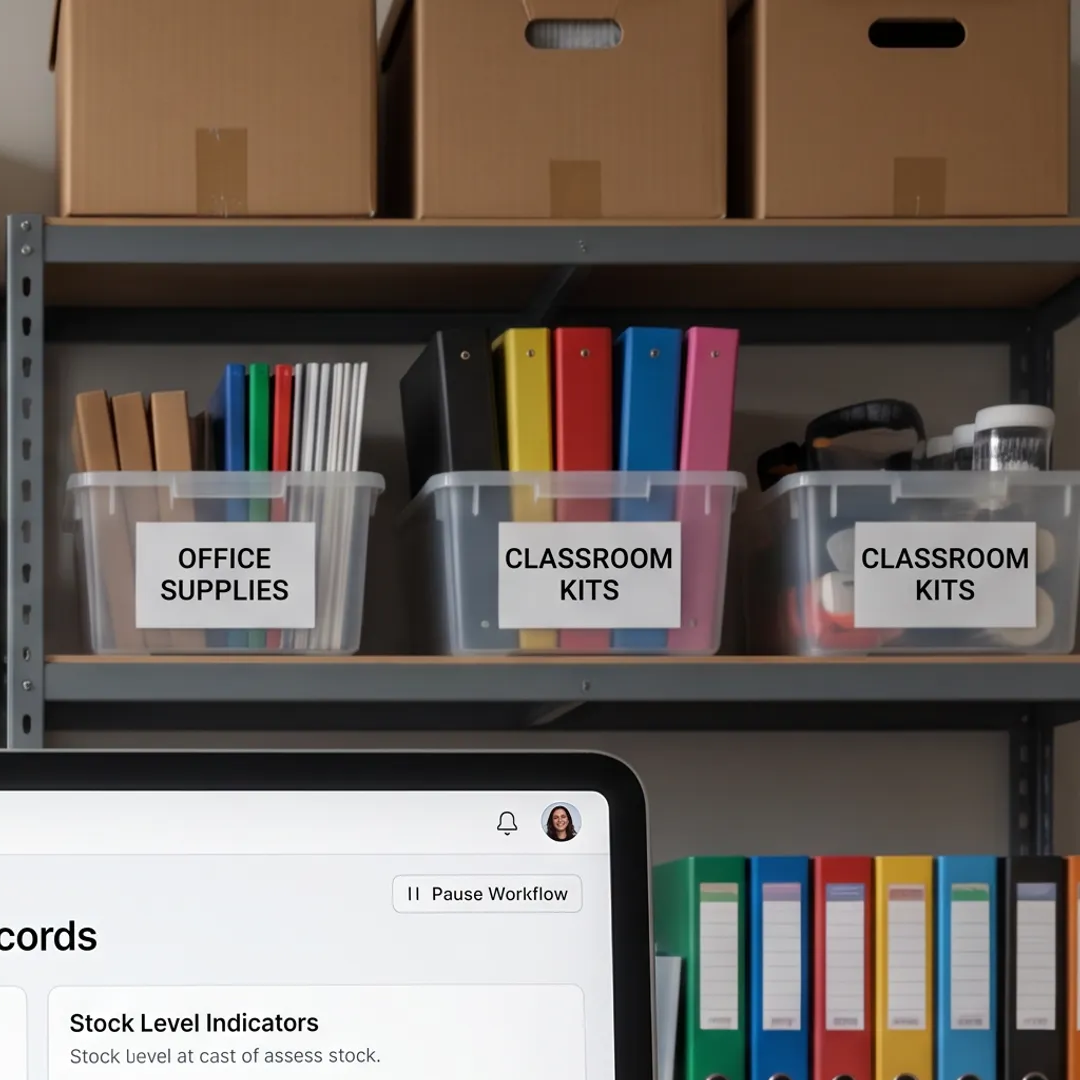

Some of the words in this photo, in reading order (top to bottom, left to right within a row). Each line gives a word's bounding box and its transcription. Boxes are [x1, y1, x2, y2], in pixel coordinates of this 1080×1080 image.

[178, 547, 271, 569] OFFICE
[505, 547, 673, 570] CLASSROOM
[861, 547, 1029, 569] CLASSROOM
[160, 578, 289, 601] SUPPLIES
[560, 578, 620, 601] KITS
[916, 578, 975, 601] KITS
[432, 886, 484, 902] Pause
[488, 886, 569, 901] Workflow
[69, 1013, 135, 1033] Stock
[141, 1013, 200, 1033] Level
[206, 1012, 319, 1033] Indicators
[70, 1048, 121, 1065] Stock
[177, 1049, 194, 1064] at
[199, 1049, 237, 1064] cast
[241, 1047, 260, 1064] of
[264, 1050, 323, 1064] assess
[328, 1047, 381, 1064] stock.
